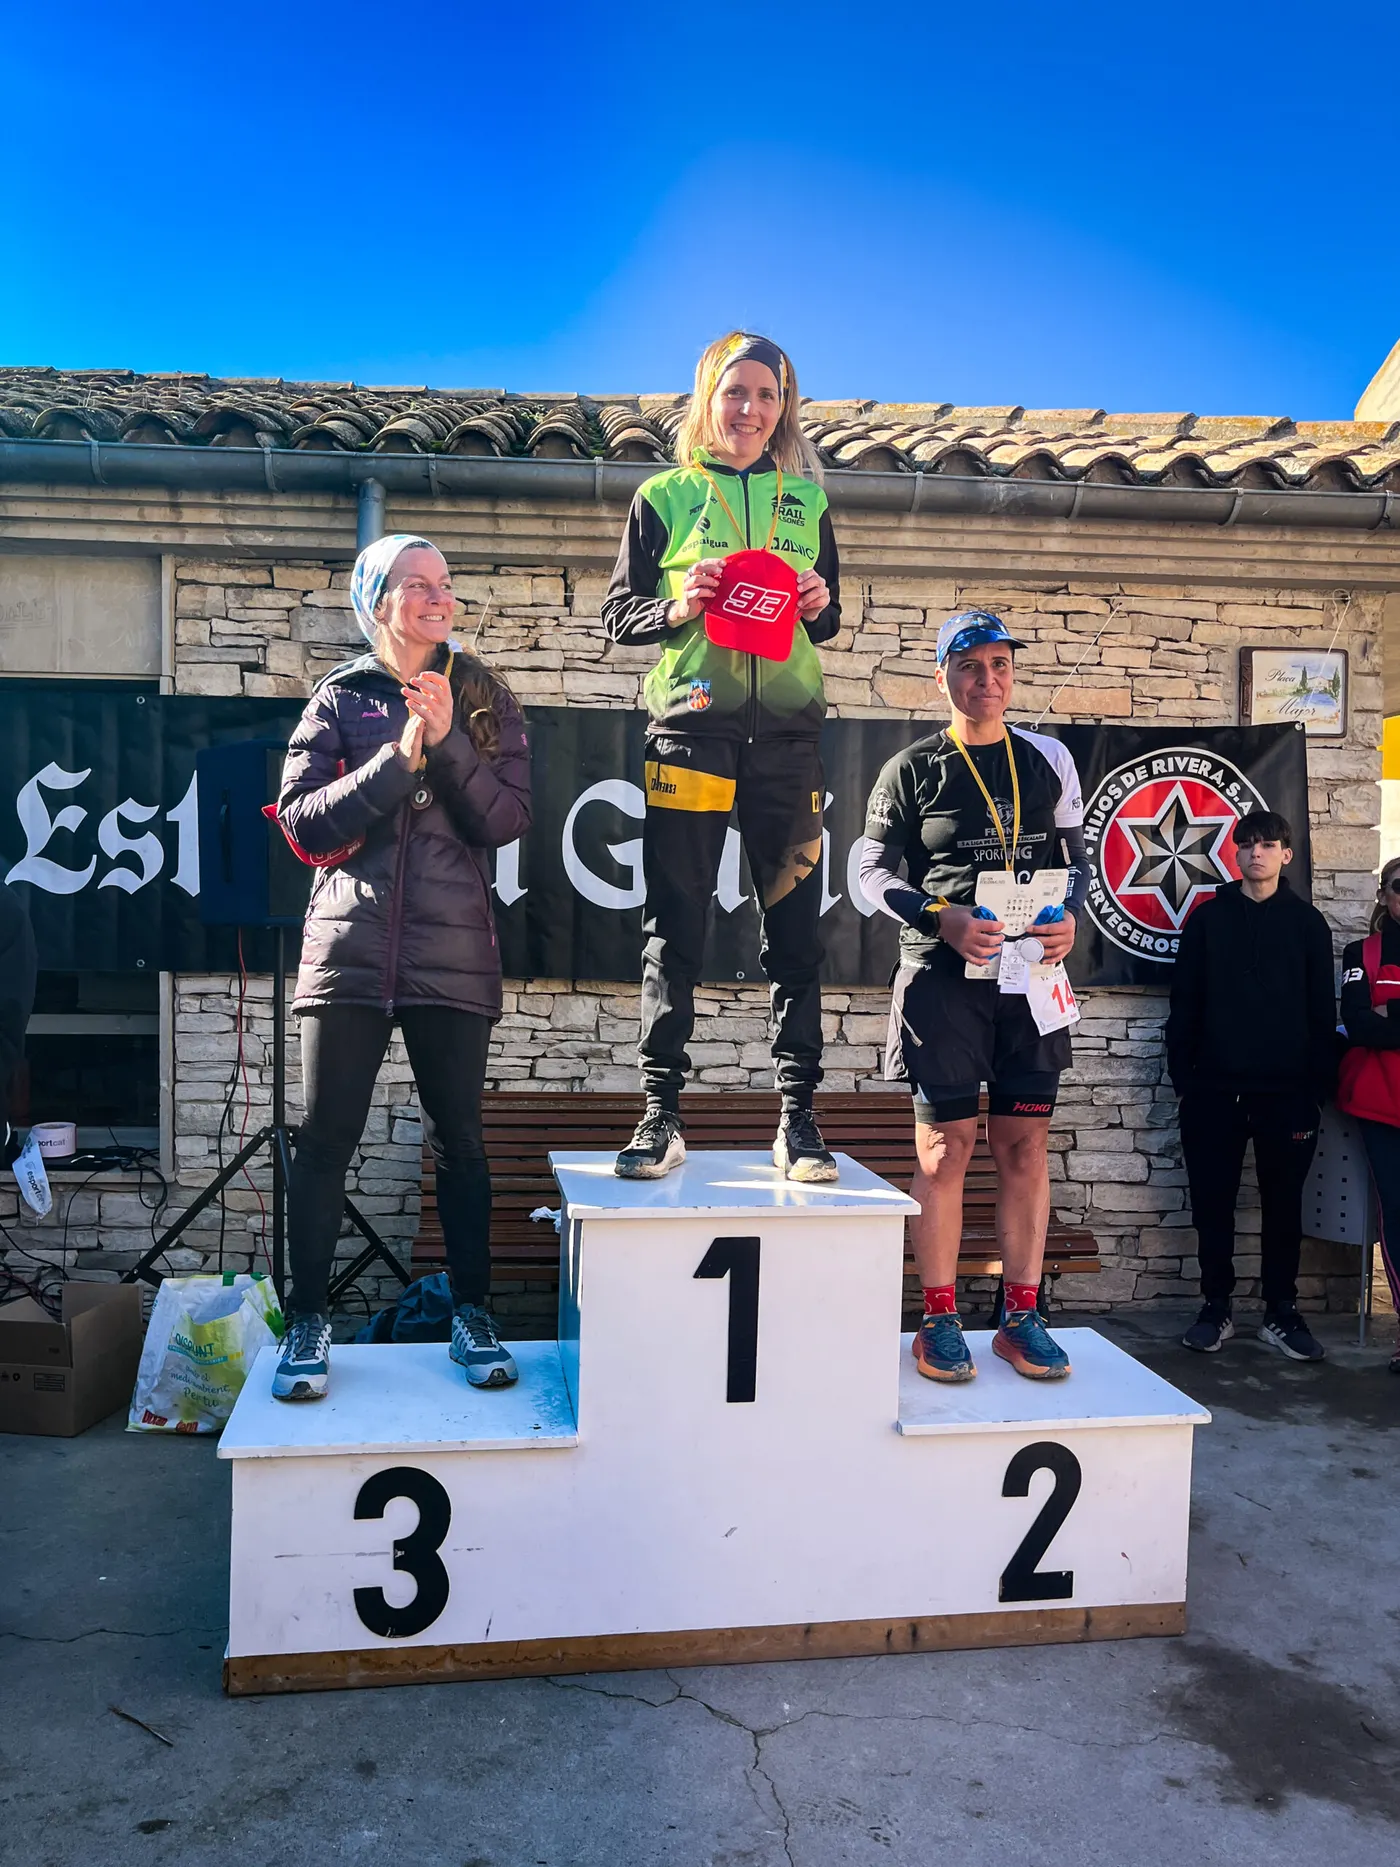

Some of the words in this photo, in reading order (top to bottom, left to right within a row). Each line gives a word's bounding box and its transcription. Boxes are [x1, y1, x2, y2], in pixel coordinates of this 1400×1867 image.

[771, 505, 806, 521] TRAIL
[682, 537, 729, 553] espaigua
[722, 581, 791, 623] 93
[1267, 697, 1316, 721] Major
[1083, 784, 1123, 842] HIJOS
[1120, 764, 1149, 789] DE
[1152, 756, 1226, 788] RIVERA,
[1051, 979, 1076, 1014] 14
[1012, 1101, 1052, 1113] HOKO
[693, 1237, 761, 1403] 1
[1000, 1441, 1083, 1604] 2
[353, 1466, 451, 1639] 3
